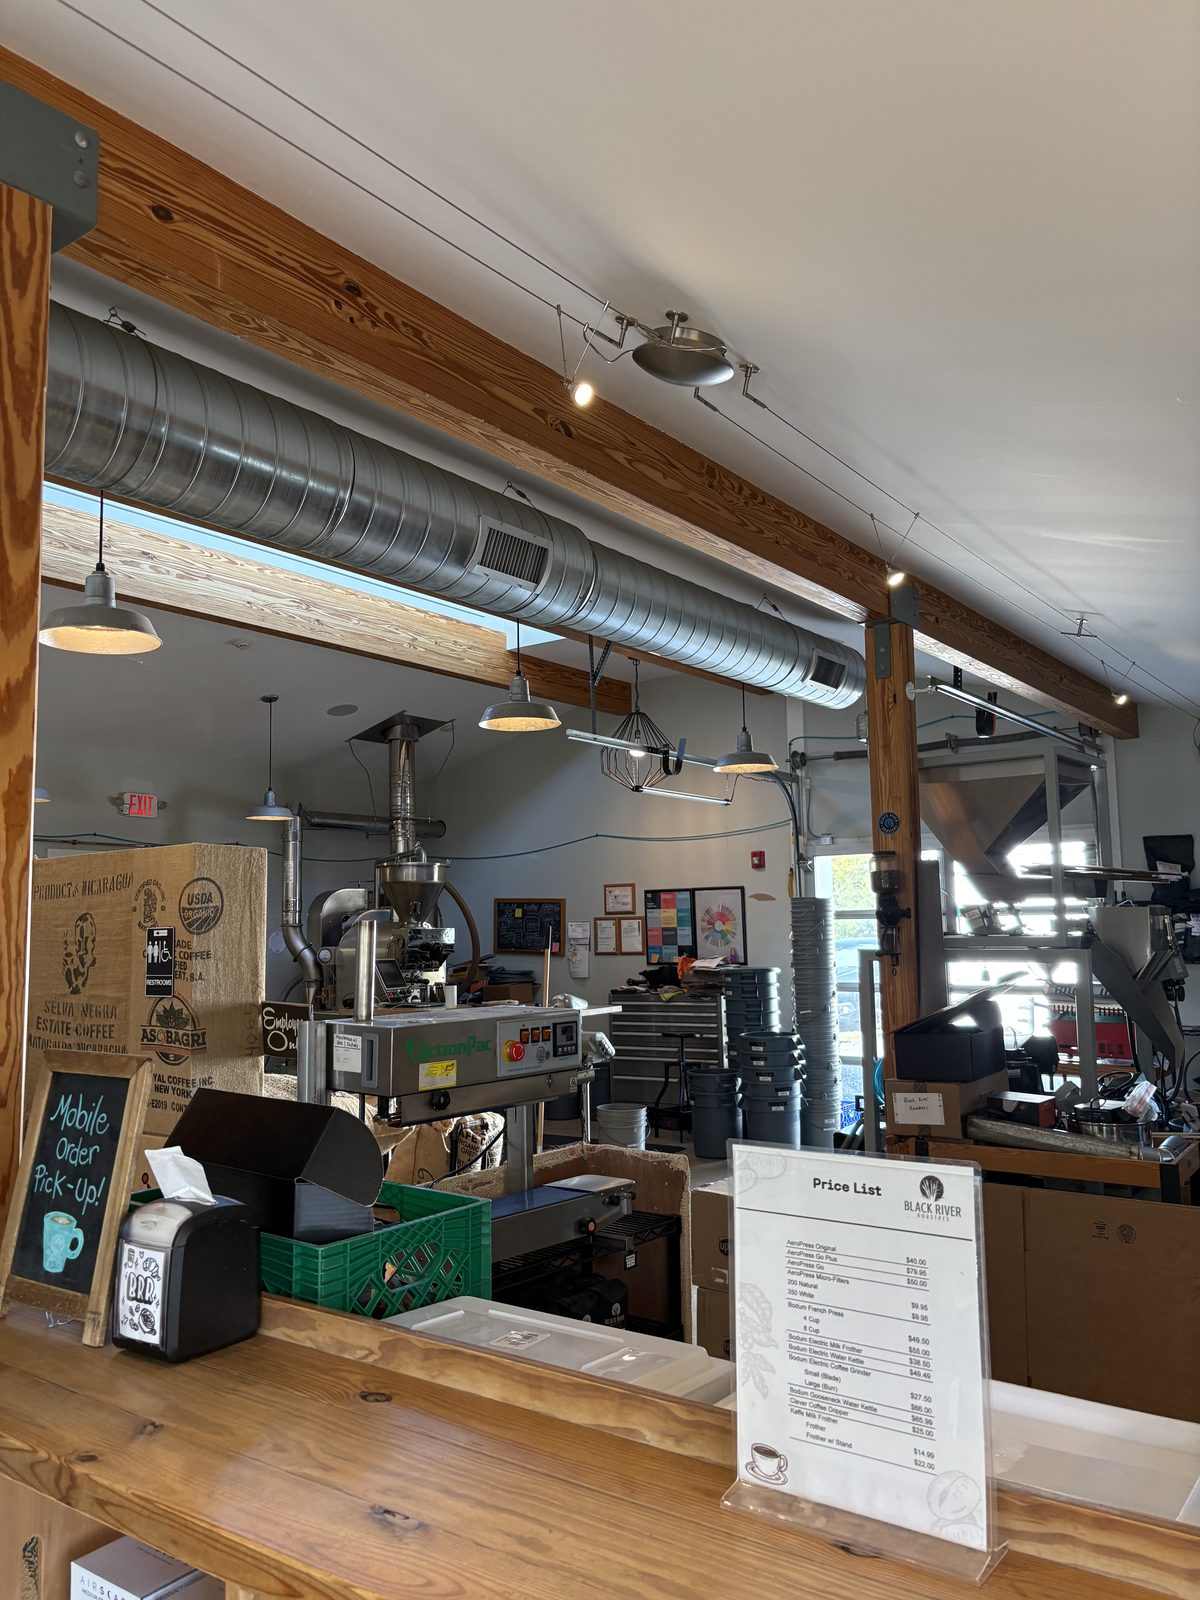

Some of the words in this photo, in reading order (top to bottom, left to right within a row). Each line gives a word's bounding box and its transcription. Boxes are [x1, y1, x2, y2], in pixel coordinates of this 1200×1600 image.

[130, 794, 153, 816] EXIT
[82, 872, 134, 896] NICARAGUA
[187, 892, 213, 906] USDA
[179, 950, 212, 961] COFFEE
[44, 1000, 74, 1017] SELVA
[80, 1003, 117, 1019] NEGRA
[263, 1007, 303, 1036] Employ
[36, 1016, 71, 1036] ESTATE
[75, 1023, 115, 1040] COFFEE
[141, 1028, 207, 1047] ASOBAGRI
[154, 1084, 169, 1095] NEW
[171, 1086, 192, 1099] YORK
[167, 1075, 196, 1088] COFFEE
[50, 1093, 109, 1136] Mobile
[56, 1137, 100, 1167] Order
[34, 1164, 105, 1215] Pick-Up!
[813, 1178, 850, 1192] Price
[854, 1182, 882, 1196] List
[904, 1201, 933, 1214] BLACK
[936, 1204, 962, 1218] RIVER
[787, 1240, 814, 1249] AeroPress
[815, 1243, 836, 1252] Original
[906, 1256, 927, 1266] $40.00
[787, 1250, 815, 1259] AeroPress
[906, 1267, 927, 1277] $79.95
[787, 1259, 815, 1269] AeroPress
[907, 1278, 927, 1287] $50.00
[787, 1269, 815, 1279] AeroPress
[816, 1274, 850, 1285] Micro-Filters
[127, 1272, 155, 1305] BRR
[799, 1281, 818, 1289] Natural
[911, 1302, 928, 1311] $9.95
[788, 1301, 807, 1310] Bodum
[808, 1305, 827, 1314] French
[828, 1309, 844, 1318] Press
[799, 1290, 815, 1299] White
[912, 1313, 929, 1322] $9.95
[808, 1316, 820, 1324] Cup
[908, 1335, 930, 1345] $49.50
[808, 1326, 820, 1334] Cup
[909, 1346, 930, 1357] $55.00
[788, 1333, 808, 1342] Bodum
[809, 1337, 829, 1347] Electric
[842, 1344, 863, 1354] Frother
[788, 1343, 808, 1353] Bodum
[809, 1347, 829, 1358] Electric
[830, 1352, 847, 1361] Water
[848, 1356, 864, 1365] Kettle
[909, 1368, 931, 1380] $49.49
[788, 1353, 808, 1363] Bodum
[809, 1358, 829, 1368] Electric
[830, 1362, 849, 1372] Coffee
[850, 1367, 871, 1377] Grinder
[804, 1369, 820, 1378] Small
[821, 1372, 841, 1383] (Blade)
[910, 1392, 932, 1403] $27.50
[804, 1379, 820, 1388] Large
[821, 1383, 838, 1393] (Burr)
[790, 1386, 809, 1396] Bodum
[810, 1392, 841, 1404] Gooseneck
[842, 1399, 859, 1408] Water
[861, 1403, 878, 1413] Kettle
[790, 1408, 804, 1416] Kaffe
[806, 1411, 816, 1419] Milk
[818, 1414, 839, 1424] Frother
[790, 1397, 807, 1407] Clever
[809, 1402, 827, 1411] Coffee
[828, 1406, 849, 1416] Dripper
[912, 1426, 934, 1438] $25.00
[806, 1421, 826, 1431] Frother
[914, 1448, 935, 1459] $14.99
[806, 1432, 827, 1442] Frother
[835, 1439, 853, 1449] Stand
[914, 1459, 936, 1471] $22.00
[80, 1575, 125, 1600] AIRSCA
